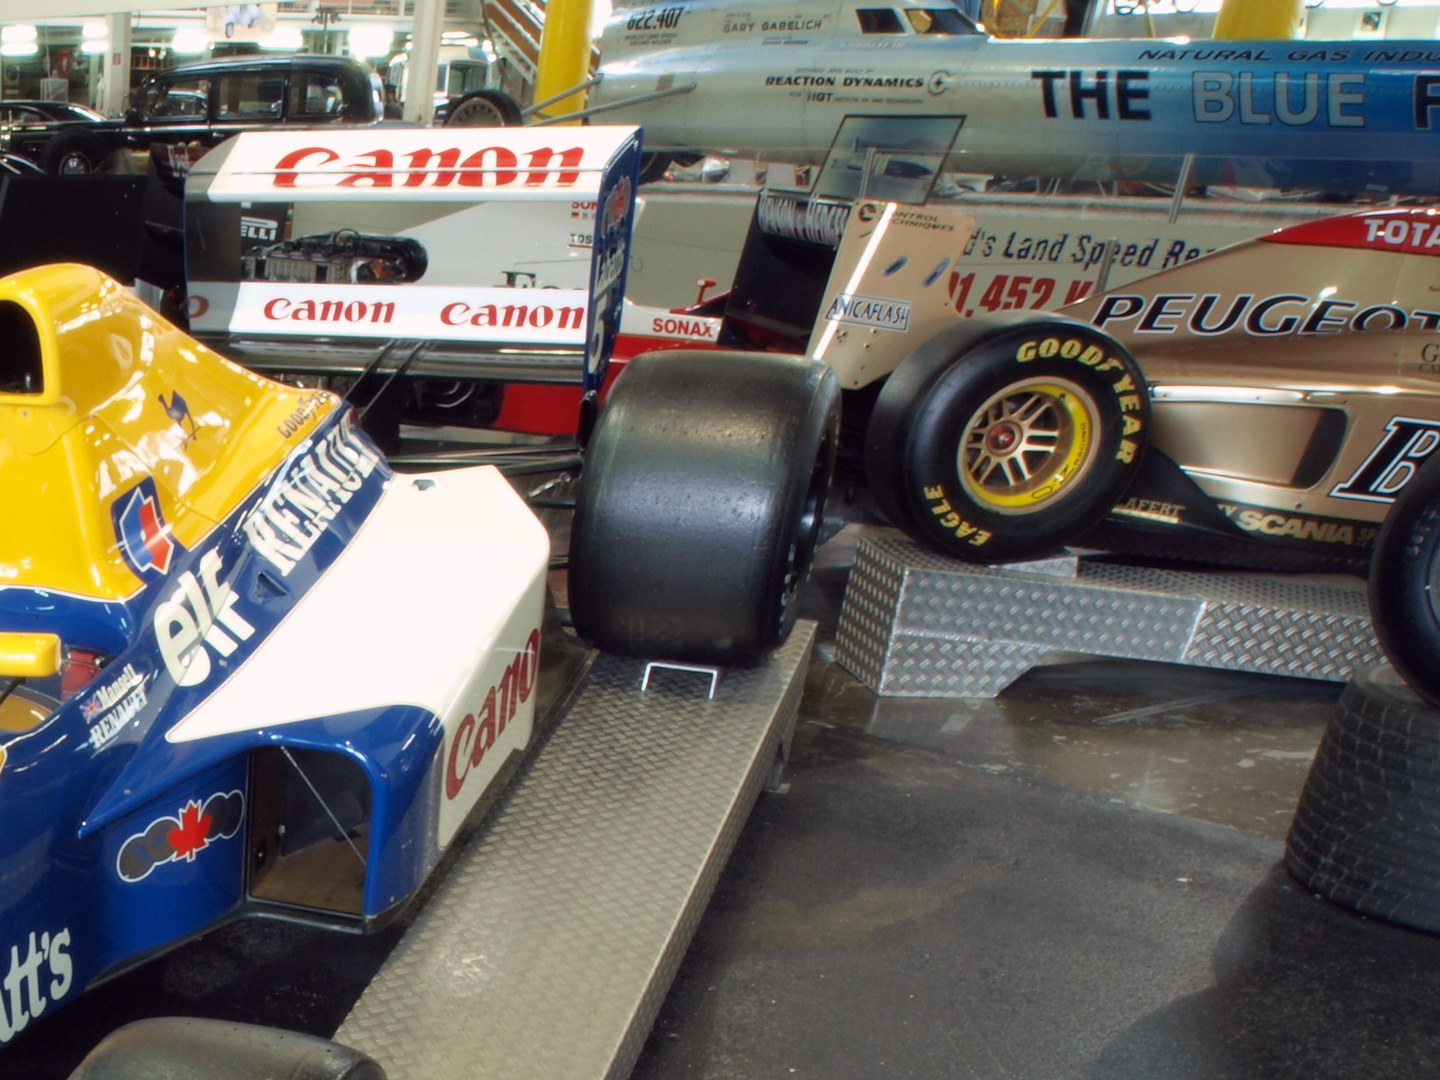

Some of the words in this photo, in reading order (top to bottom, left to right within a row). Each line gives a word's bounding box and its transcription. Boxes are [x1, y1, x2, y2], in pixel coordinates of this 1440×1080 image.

[723, 23, 755, 33] GARY
[761, 20, 822, 31] GABELICH
[1138, 49, 1273, 62] NATURAL
[1287, 49, 1351, 62] GAS
[765, 76, 836, 87] REACTION
[843, 77, 925, 88] DYNAMICS
[1031, 70, 1152, 121] THE
[1191, 71, 1366, 127] BLUE
[273, 146, 584, 188] Canon
[882, 209, 939, 222] ONTROL
[891, 218, 955, 232] CHNIQUES
[1002, 231, 1069, 262] Land
[1071, 234, 1154, 272] Speed
[264, 297, 395, 324] Canon
[440, 301, 584, 330] Canon
[652, 317, 714, 338] SONAX
[1016, 338, 1134, 464] GOODYEAR
[242, 408, 381, 576] RENAULT
[923, 483, 992, 548] EAGLE
[1234, 508, 1354, 546] SCANIA
[153, 546, 256, 688] elf
[97, 663, 138, 710] Mansell
[90, 684, 148, 749] RENAULT
